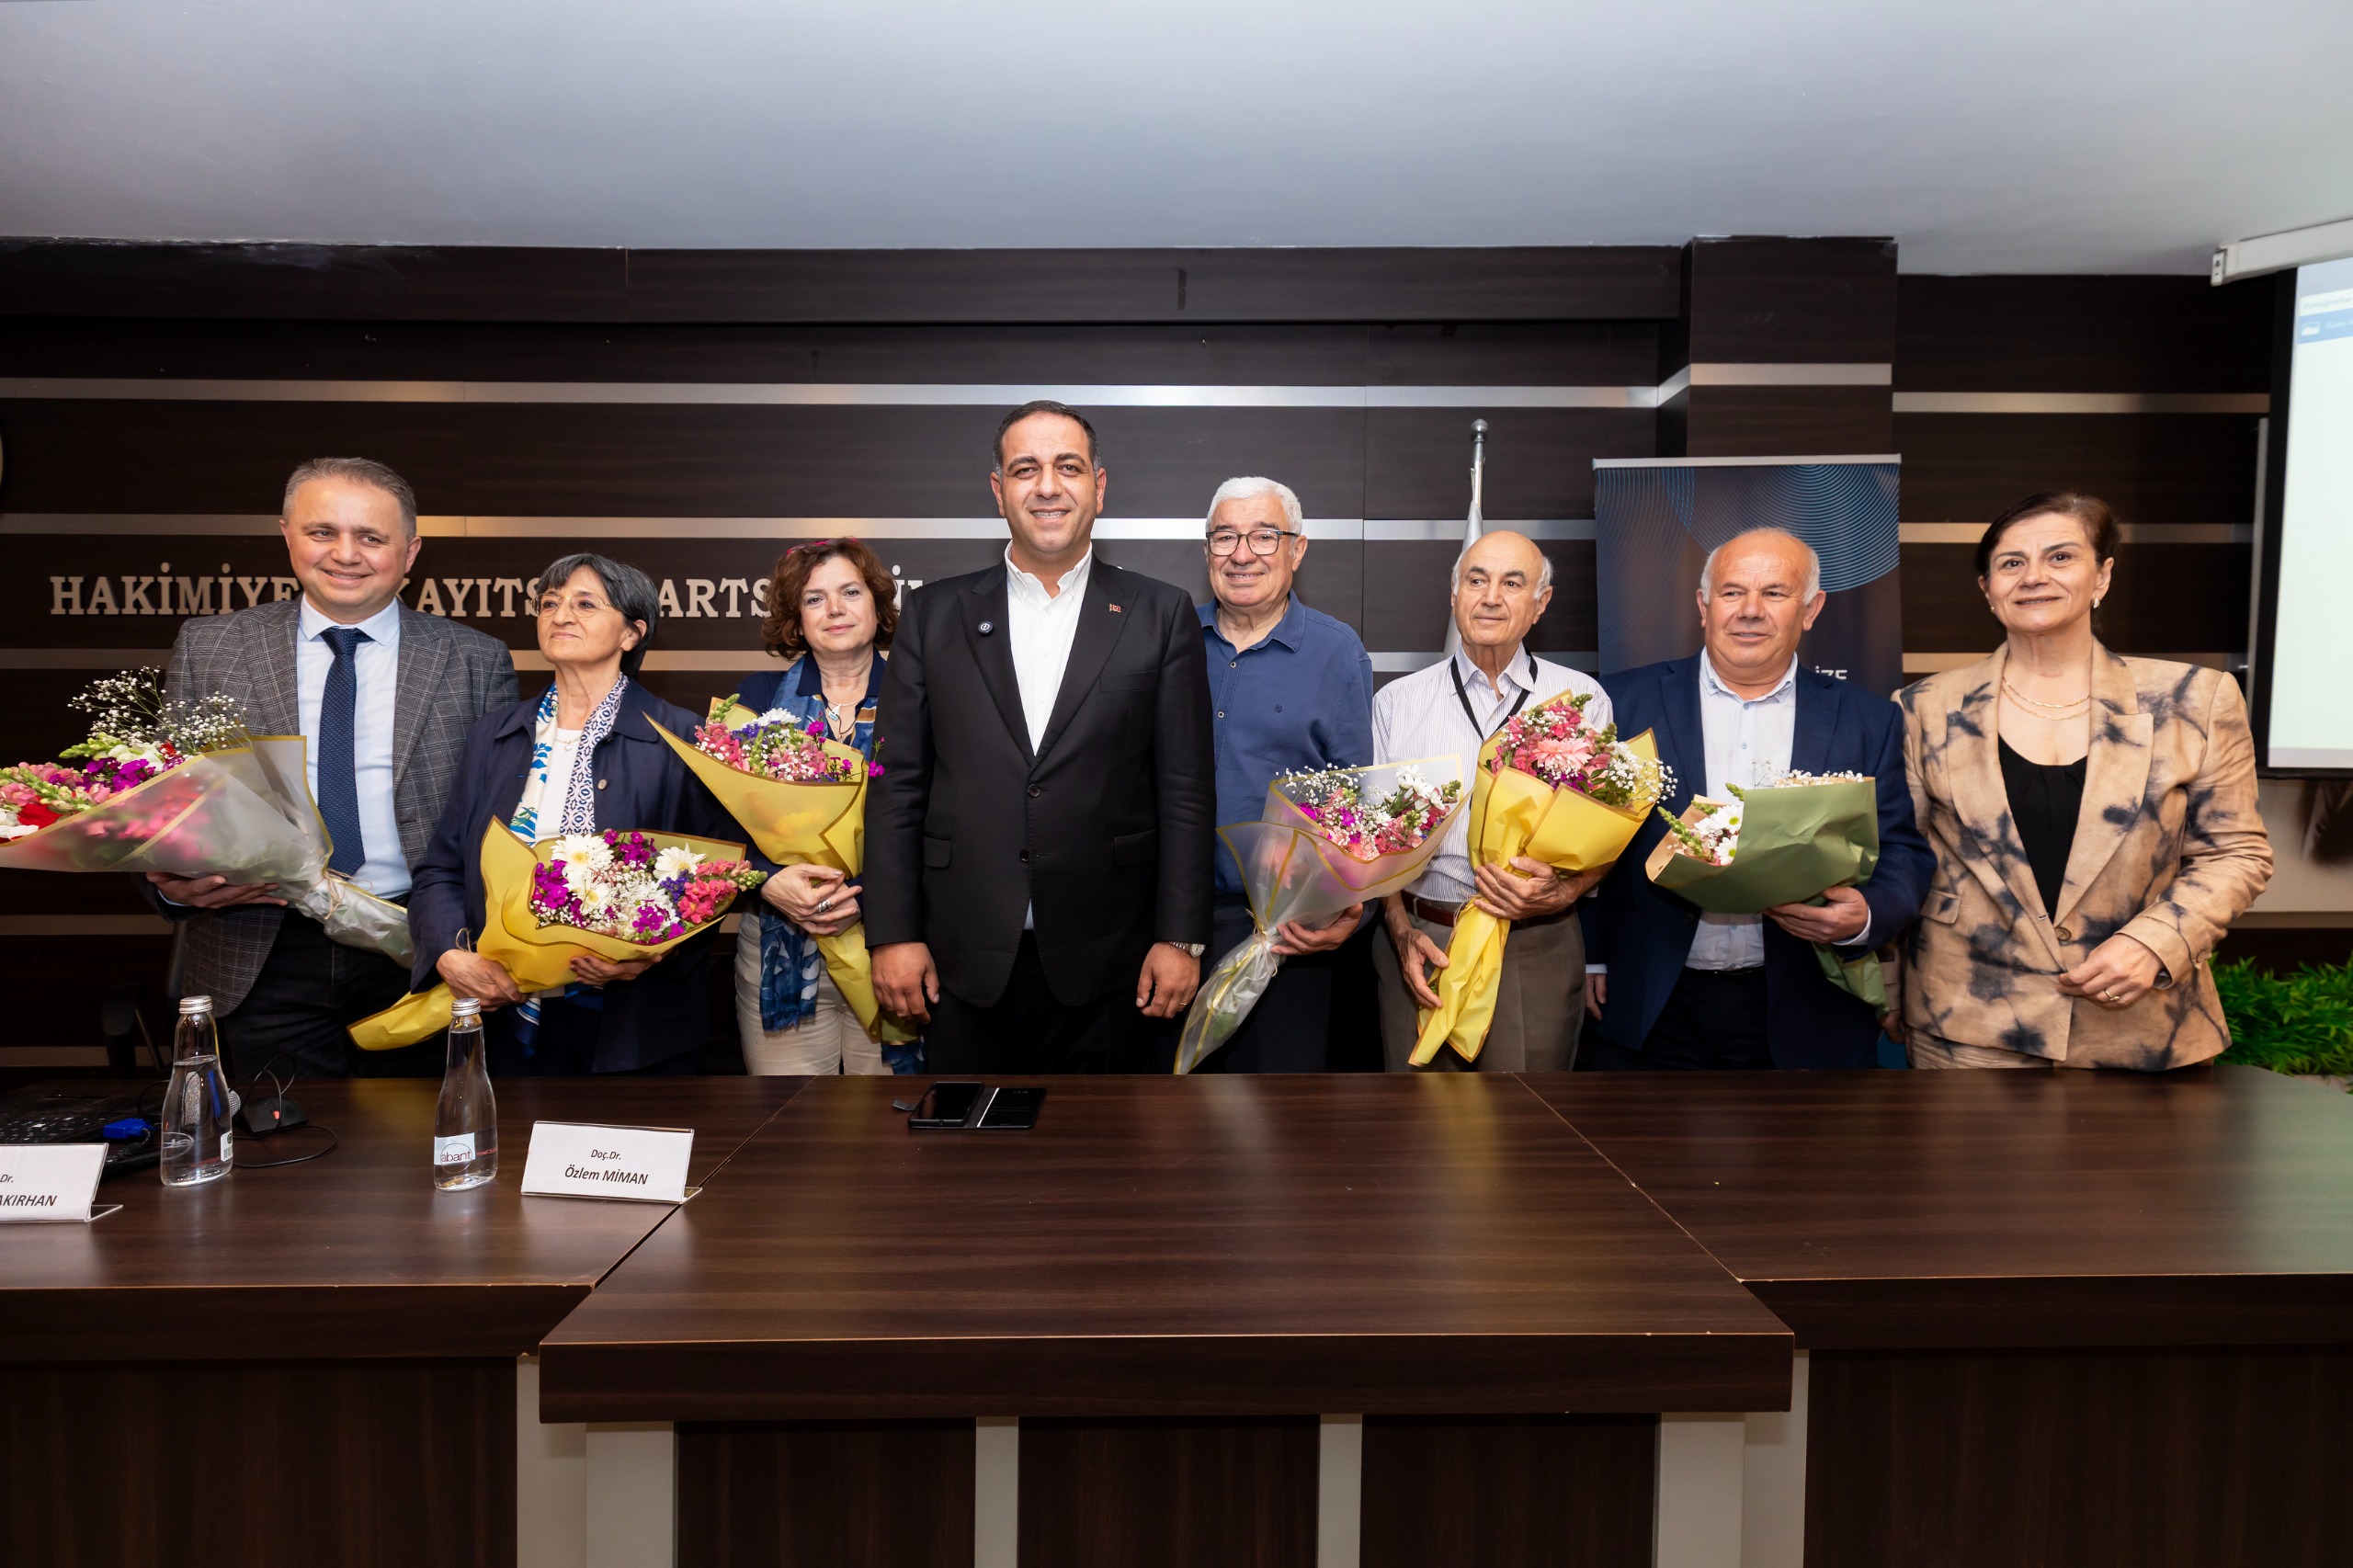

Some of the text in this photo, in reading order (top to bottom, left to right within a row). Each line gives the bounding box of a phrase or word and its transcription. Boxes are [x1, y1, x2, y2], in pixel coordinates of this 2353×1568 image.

[50, 562, 772, 618] HAKİMİYE AYITS ARTS
[441, 1150, 472, 1162] abant
[564, 1164, 649, 1185] Özlem MİMAN
